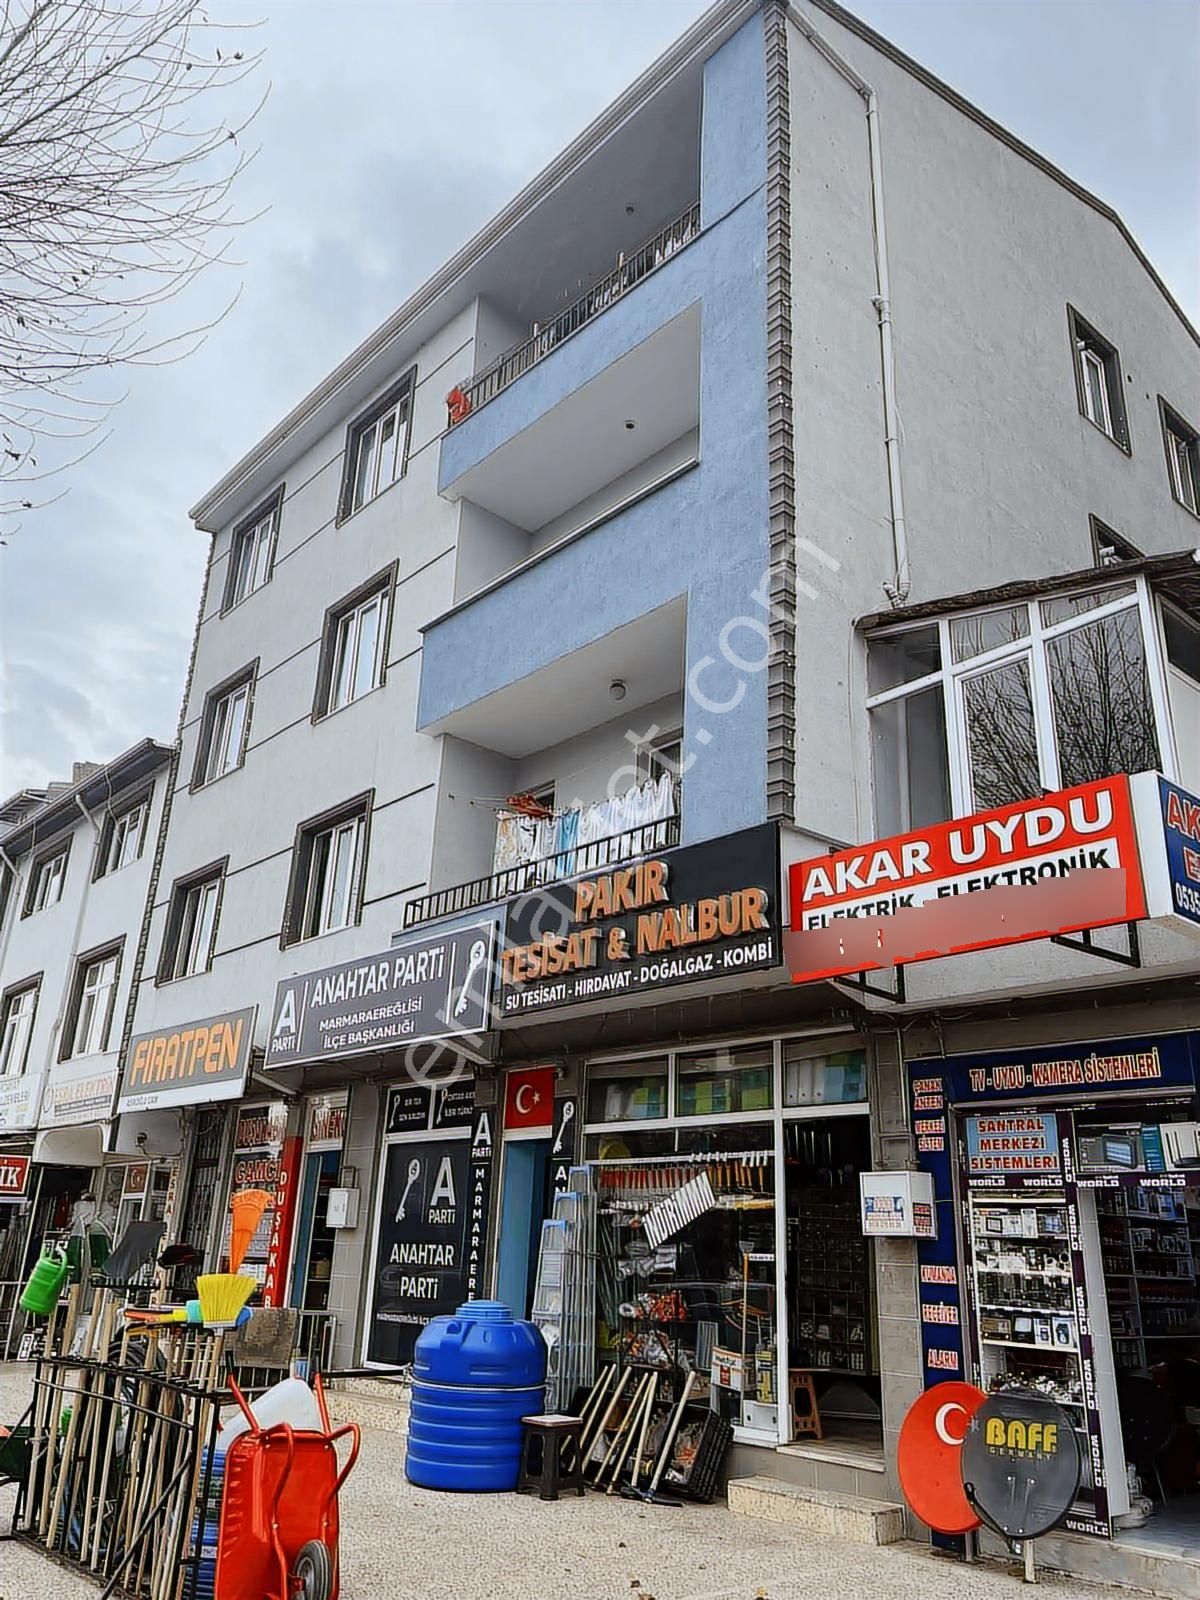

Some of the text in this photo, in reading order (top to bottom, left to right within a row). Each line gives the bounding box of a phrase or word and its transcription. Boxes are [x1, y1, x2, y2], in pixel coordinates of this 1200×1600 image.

[803, 789, 1113, 902] AKAR UYDU
[575, 860, 669, 923] PAKIR
[501, 887, 769, 985] TESİSAT & NALBUR
[310, 960, 390, 1008] ANAHTAR
[506, 993, 519, 1011] SU
[520, 983, 566, 1007] TESİSATI
[574, 970, 633, 997] HIRDAVAT
[640, 953, 713, 982] DOĞALGAZ
[723, 936, 773, 968] KOMBİ
[274, 989, 298, 1036] A
[319, 996, 423, 1032] MARMARAEREĞLİSİ
[323, 1019, 415, 1050] İLÇE BAŞKANLIĞI
[129, 1018, 244, 1087] FIRATPEN
[992, 1064, 1025, 1091] UYDU
[1032, 1059, 1084, 1088] KAMERA
[1083, 1047, 1162, 1084] SİSTEMLERİ
[473, 1112, 492, 1147] A
[977, 1118, 1045, 1134] SANTRAL
[430, 1157, 456, 1206] A
[968, 1178, 1005, 1187] WORLD
[1023, 1177, 1063, 1187] WORLD
[1062, 1138, 1073, 1184] WORLD
[1077, 1179, 1119, 1188] WORLD
[1140, 1177, 1186, 1187] WORLD
[1068, 1204, 1079, 1251] WORLD
[389, 1242, 455, 1267] ANAHTAR
[1076, 1286, 1088, 1336] WORLD
[927, 1348, 959, 1371] ALARM
[1083, 1359, 1095, 1411] WORLD
[985, 1417, 1057, 1452] BAFF
[1091, 1434, 1103, 1488] WORLD
[1066, 1519, 1108, 1536] WORLD
